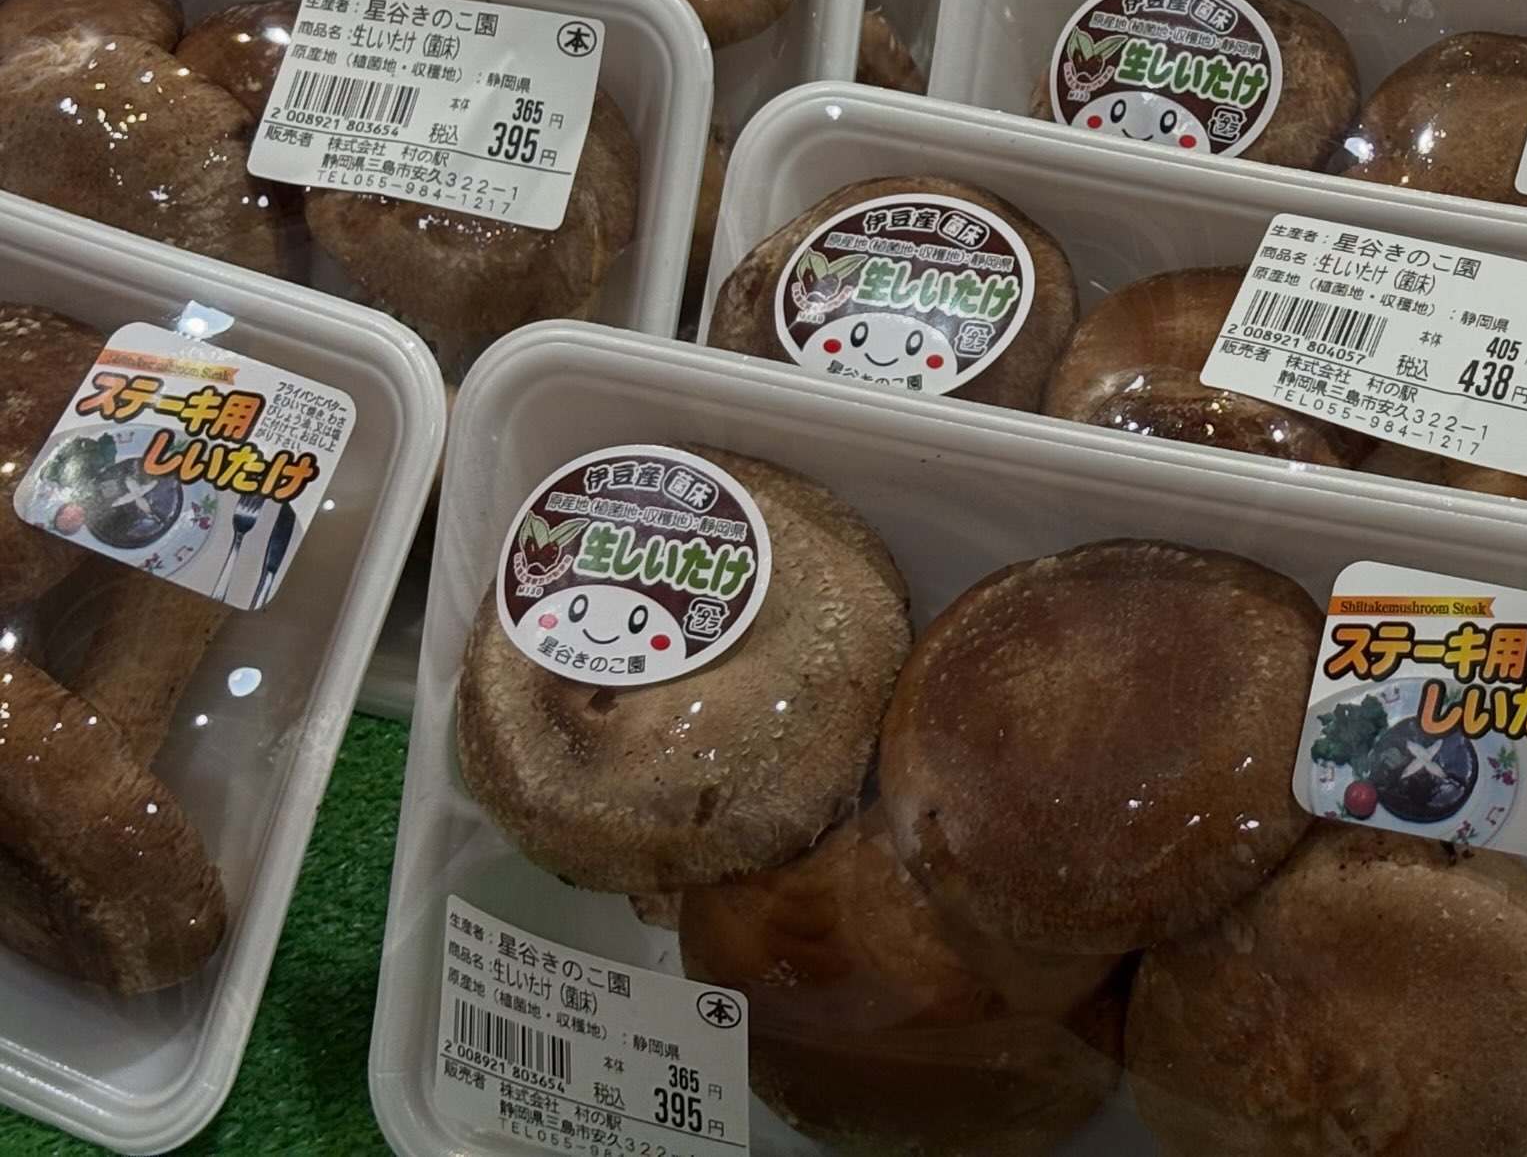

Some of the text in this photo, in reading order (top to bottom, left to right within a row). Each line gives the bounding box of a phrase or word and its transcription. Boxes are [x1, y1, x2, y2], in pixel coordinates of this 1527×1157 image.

[1115, 39, 1268, 108] 生しいたけ
[286, 111, 400, 137] 008921 803654
[865, 208, 938, 233] 伊豆産
[854, 259, 1019, 320] 生しいたけ
[1243, 327, 1367, 364] 008921 804057
[76, 371, 266, 442] ステーキ用
[142, 430, 320, 503] しいたけ
[586, 463, 711, 509] 伊豆産 菌床
[576, 523, 754, 599] 生しいたけ
[1341, 600, 1486, 615] Shiitakemushroom Steak
[538, 636, 646, 673] 星谷きのこ園
